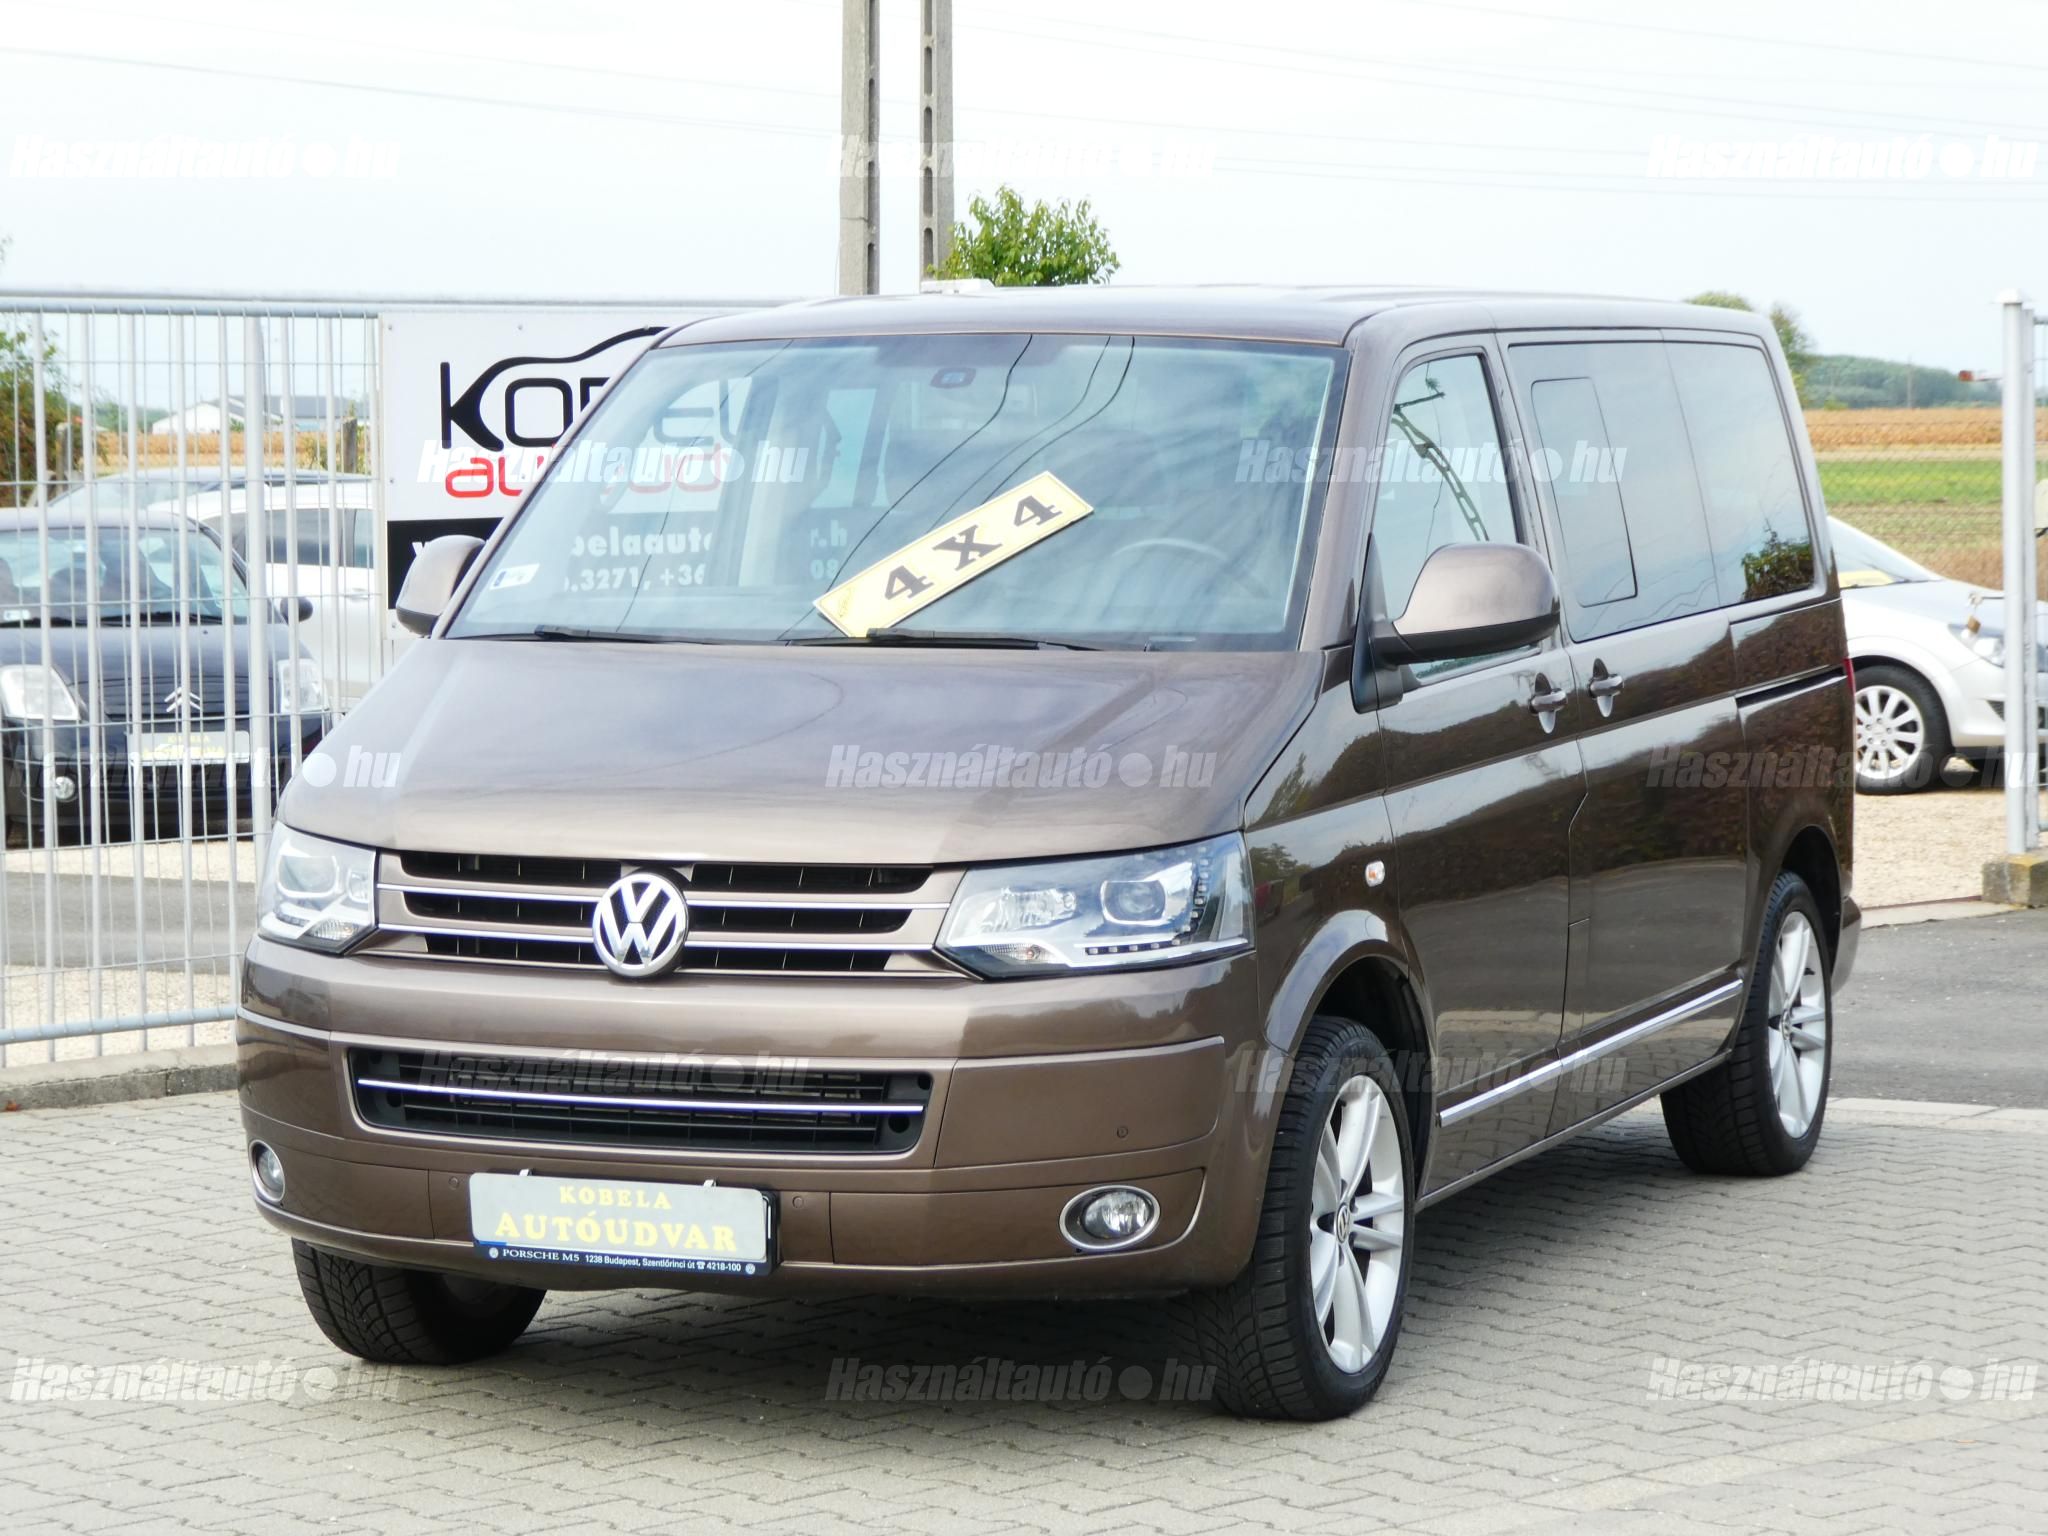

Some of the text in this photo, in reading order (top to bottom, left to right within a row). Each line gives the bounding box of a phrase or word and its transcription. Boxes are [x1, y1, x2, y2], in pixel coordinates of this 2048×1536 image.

[559, 1185, 672, 1210] KOBELA
[495, 1211, 737, 1252] AUTÓUDVAR
[503, 1248, 560, 1260] PORSCHE
[562, 1254, 580, 1262] M5
[604, 1256, 641, 1267] Budapest,
[687, 1261, 696, 1269] út
[706, 1262, 742, 1272] 4218-100
